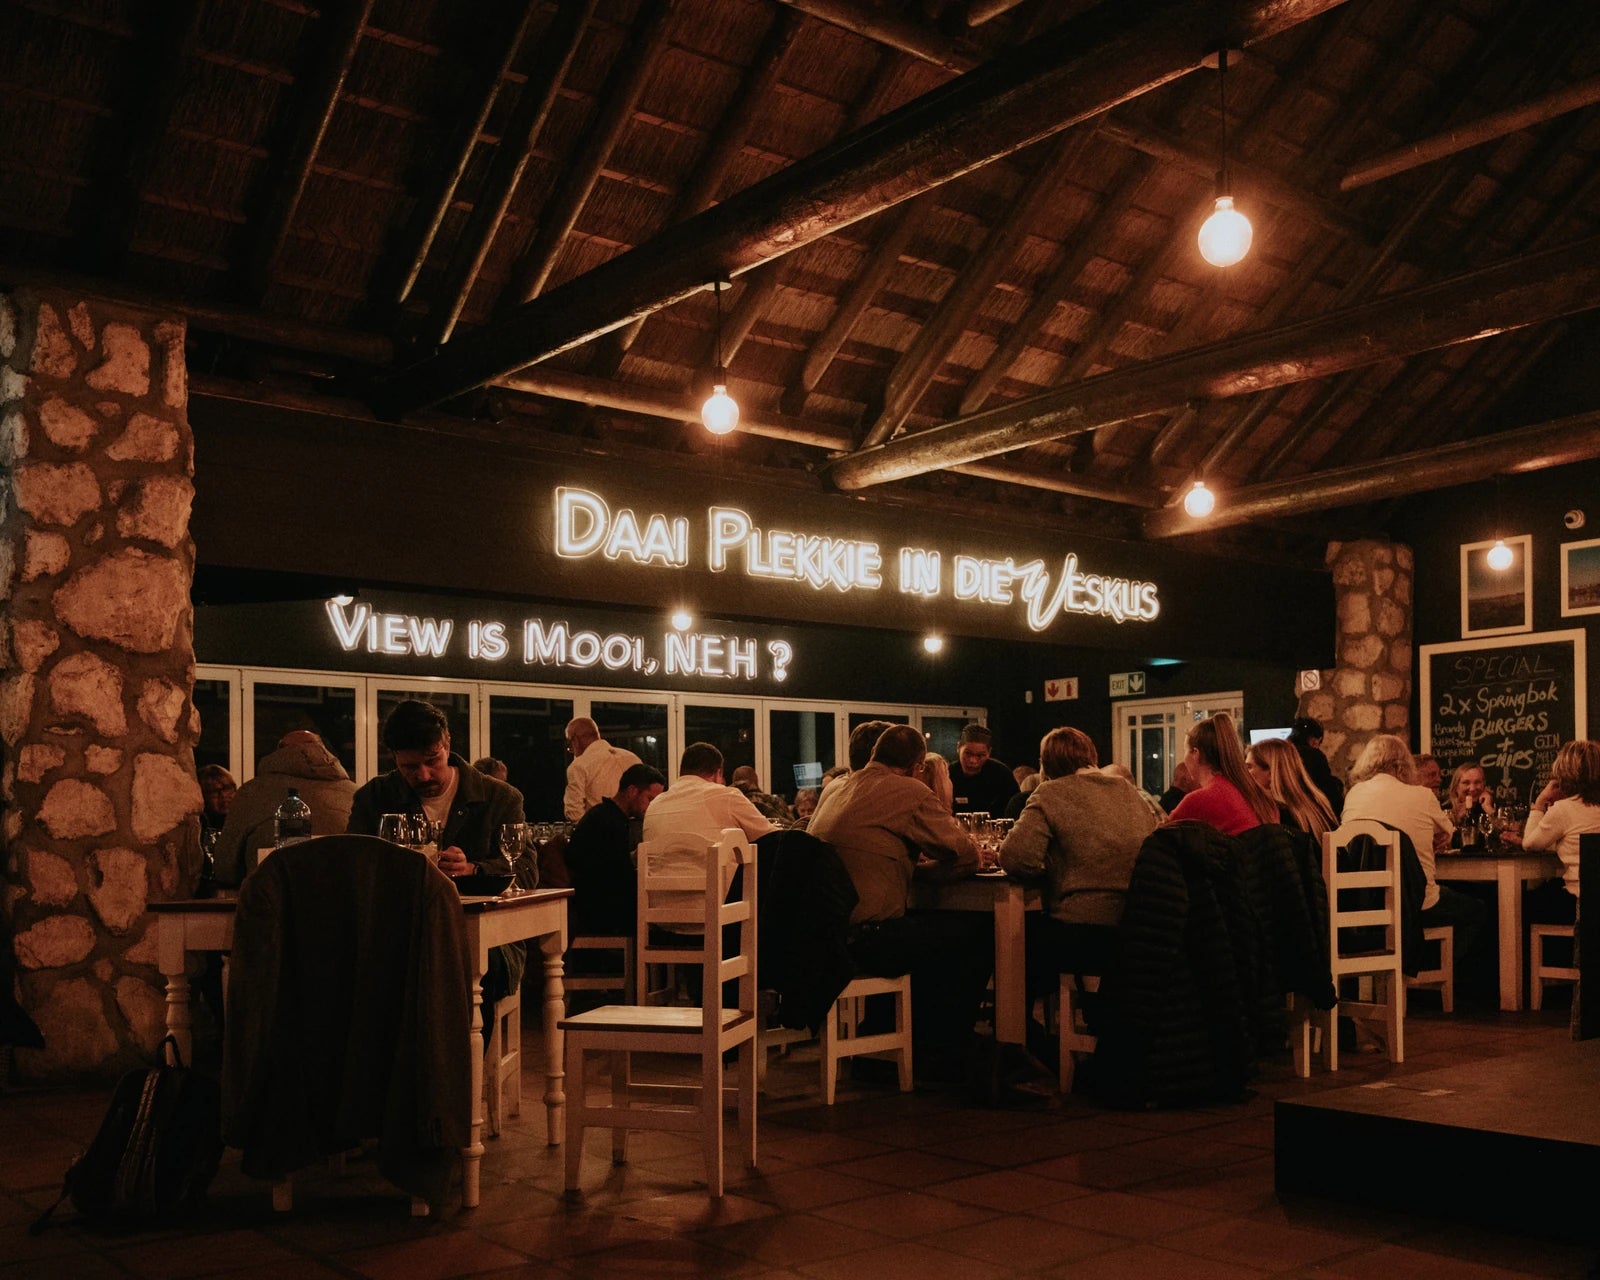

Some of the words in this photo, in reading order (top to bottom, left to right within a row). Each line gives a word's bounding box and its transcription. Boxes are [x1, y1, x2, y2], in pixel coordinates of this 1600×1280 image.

[555, 486, 689, 568] DAAI
[709, 506, 882, 592] PLEKKIE
[900, 547, 940, 597] IN
[954, 554, 1014, 605] DIE
[1007, 552, 1160, 632] WESKUS
[325, 600, 454, 658] VIEW
[468, 619, 509, 661] IS
[1454, 655, 1555, 684] SPECIAL
[1112, 680, 1124, 690] EXIT
[1470, 711, 1548, 741] BURGERS
